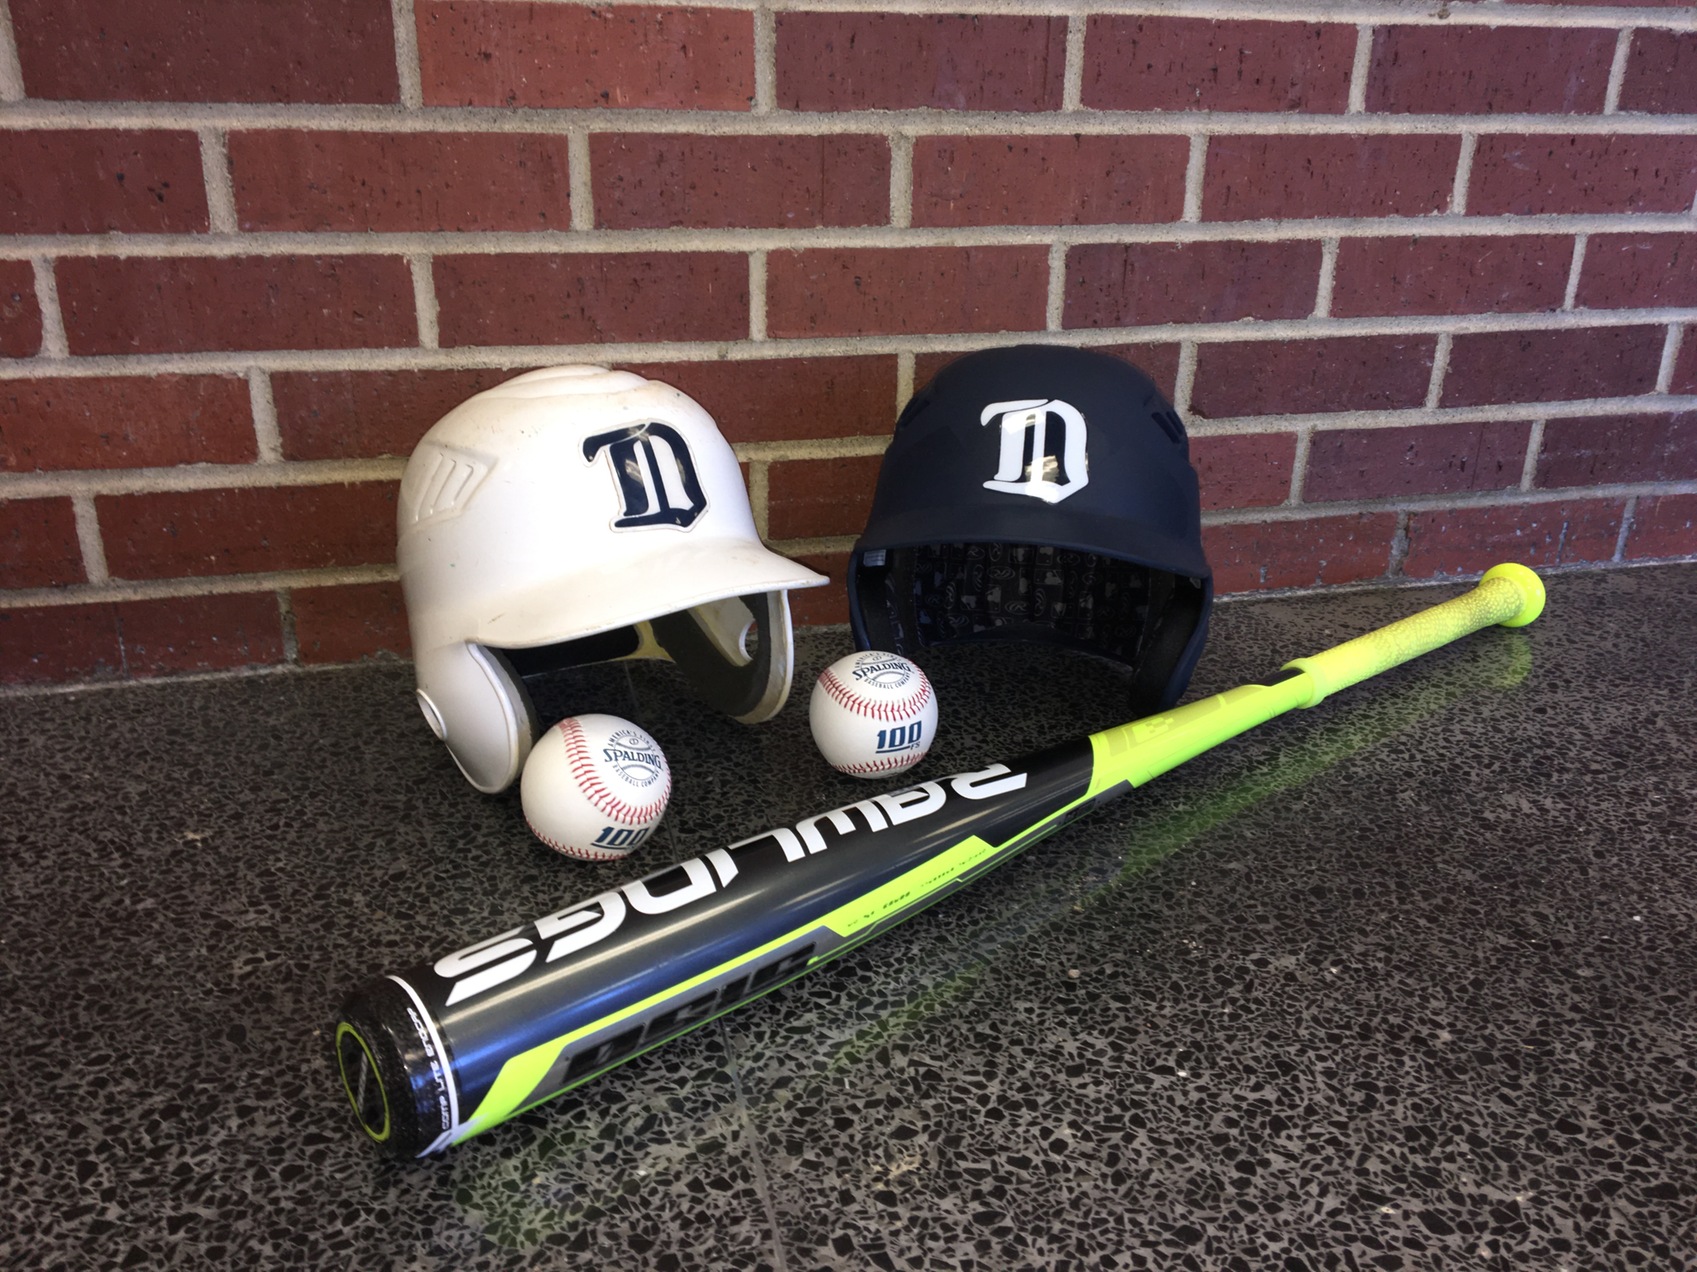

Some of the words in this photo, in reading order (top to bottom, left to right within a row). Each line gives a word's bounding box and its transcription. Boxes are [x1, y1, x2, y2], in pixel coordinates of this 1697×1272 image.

[580, 419, 709, 532] D
[852, 661, 912, 681] SPALDING
[877, 720, 922, 750] 100
[603, 748, 664, 771] SPALDING
[594, 826, 651, 846] 100
[433, 763, 1028, 1008] RAWLINGS
